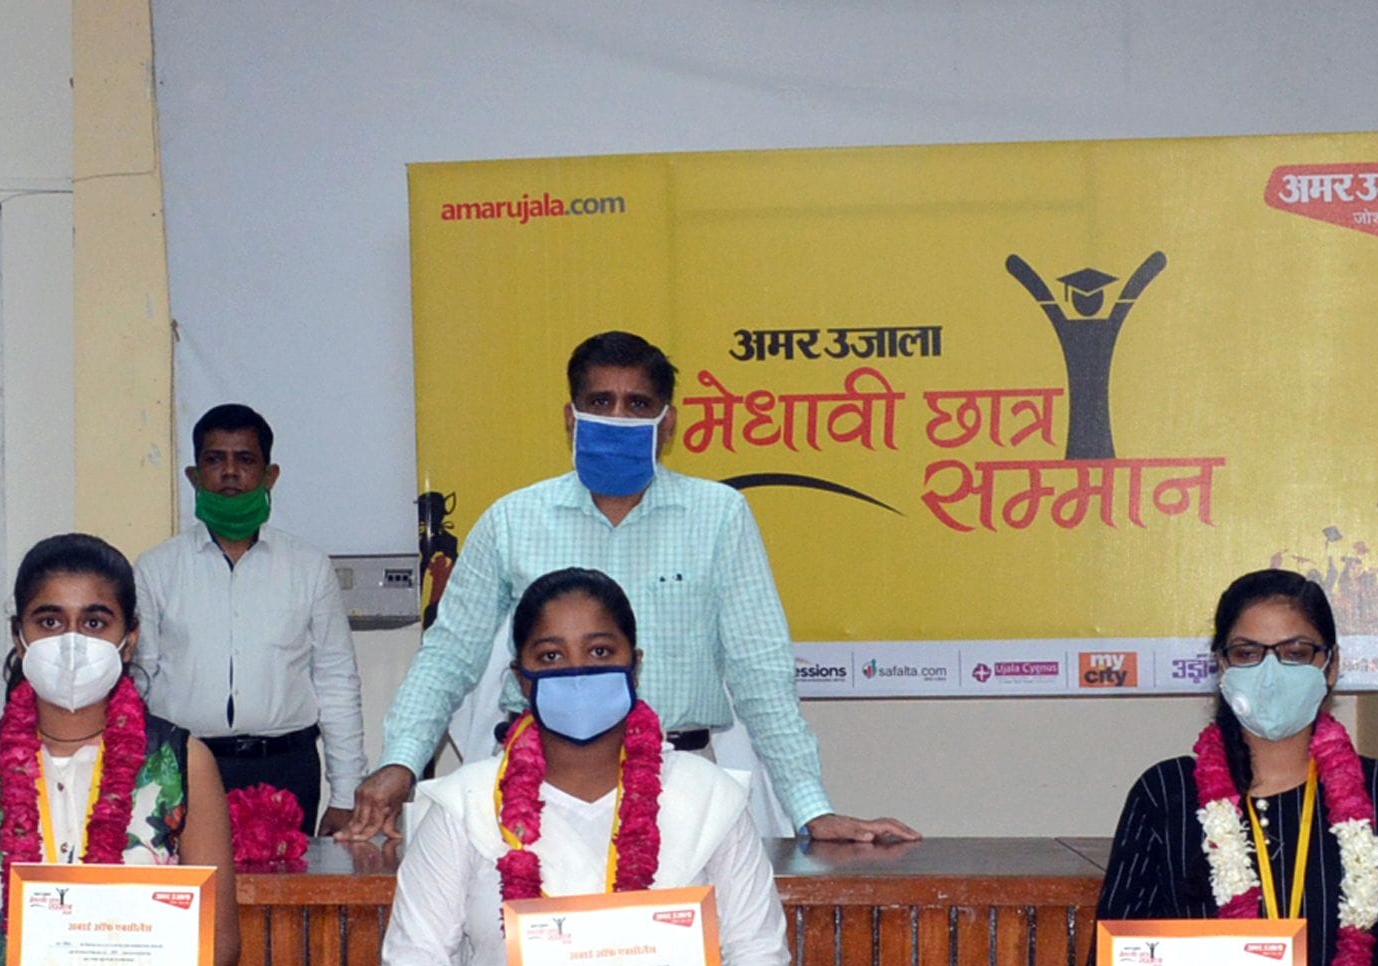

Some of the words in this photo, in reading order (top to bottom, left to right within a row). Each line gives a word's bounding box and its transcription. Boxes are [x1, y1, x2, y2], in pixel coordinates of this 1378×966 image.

[1278, 173, 1355, 203] अमर
[441, 192, 626, 225] amarujala.com
[729, 327, 820, 362] अमर
[824, 325, 943, 359] उजाला
[682, 366, 906, 454] मेधावी
[923, 387, 1064, 449] छात्र
[921, 457, 1226, 533] सम्मान
[795, 663, 847, 678] essions
[995, 662, 1020, 676] Ujala
[1022, 662, 1058, 676] Cygnus
[1084, 667, 1127, 687] city
[1089, 653, 1125, 671] my
